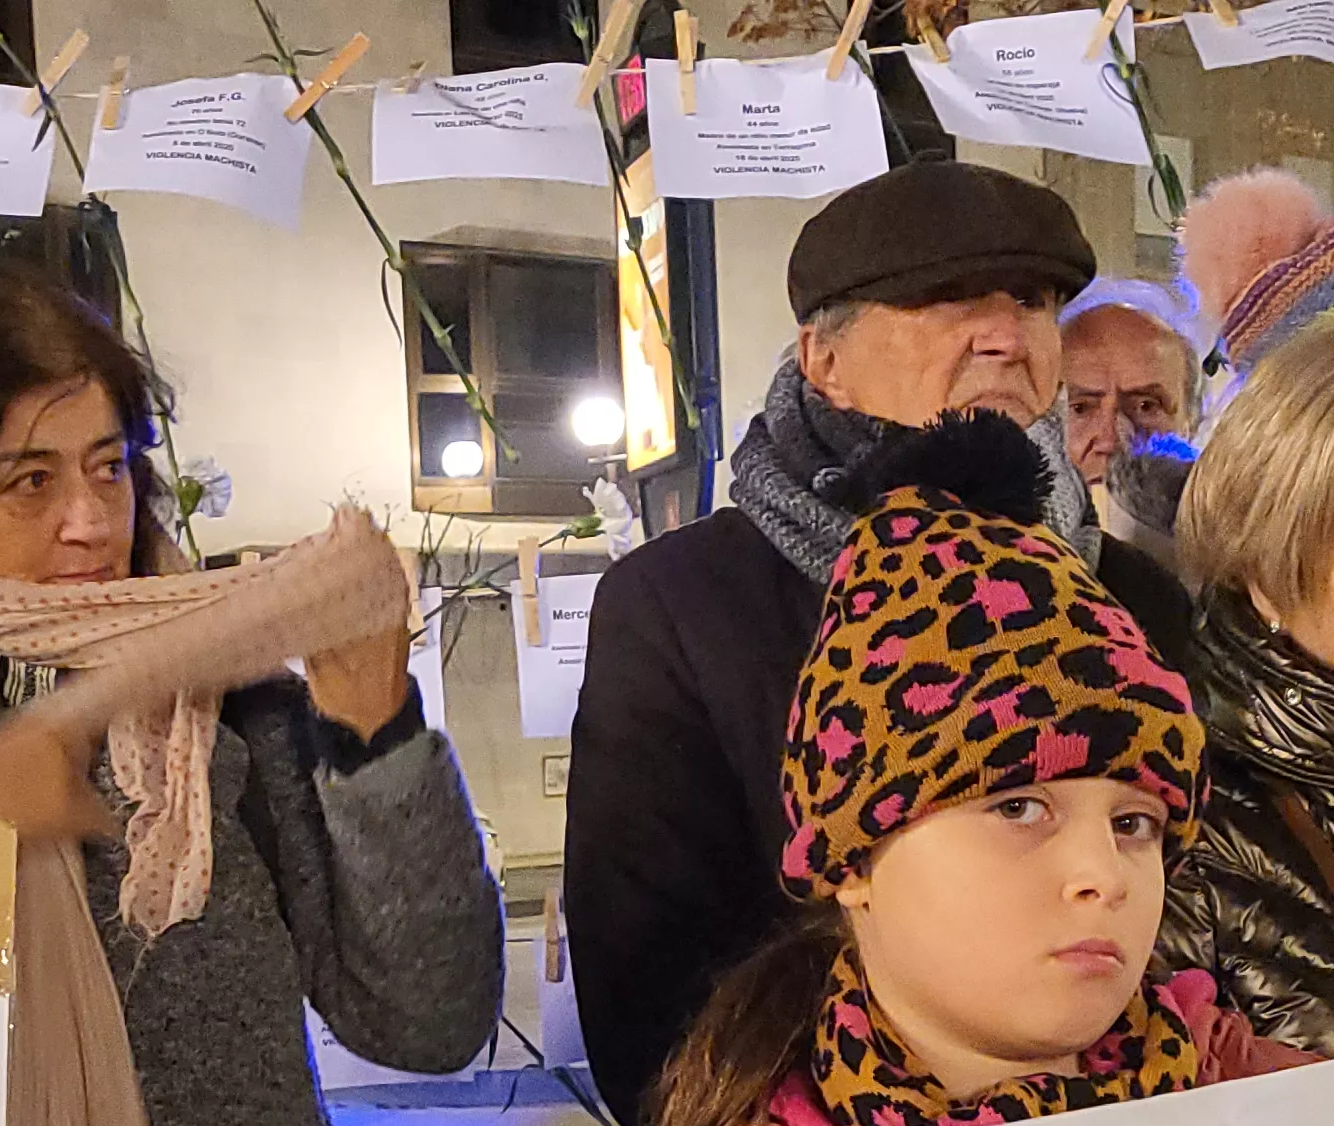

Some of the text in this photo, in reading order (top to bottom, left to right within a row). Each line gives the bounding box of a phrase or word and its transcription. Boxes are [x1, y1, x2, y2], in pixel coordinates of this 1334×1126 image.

[476, 76, 531, 92] Carolina
[171, 92, 246, 107] Josefa F.G.
[742, 104, 781, 114] Marta
[146, 151, 256, 174] VIOLENCIA MACHISTA
[713, 165, 825, 174] VIOLENCIA MACHISTA
